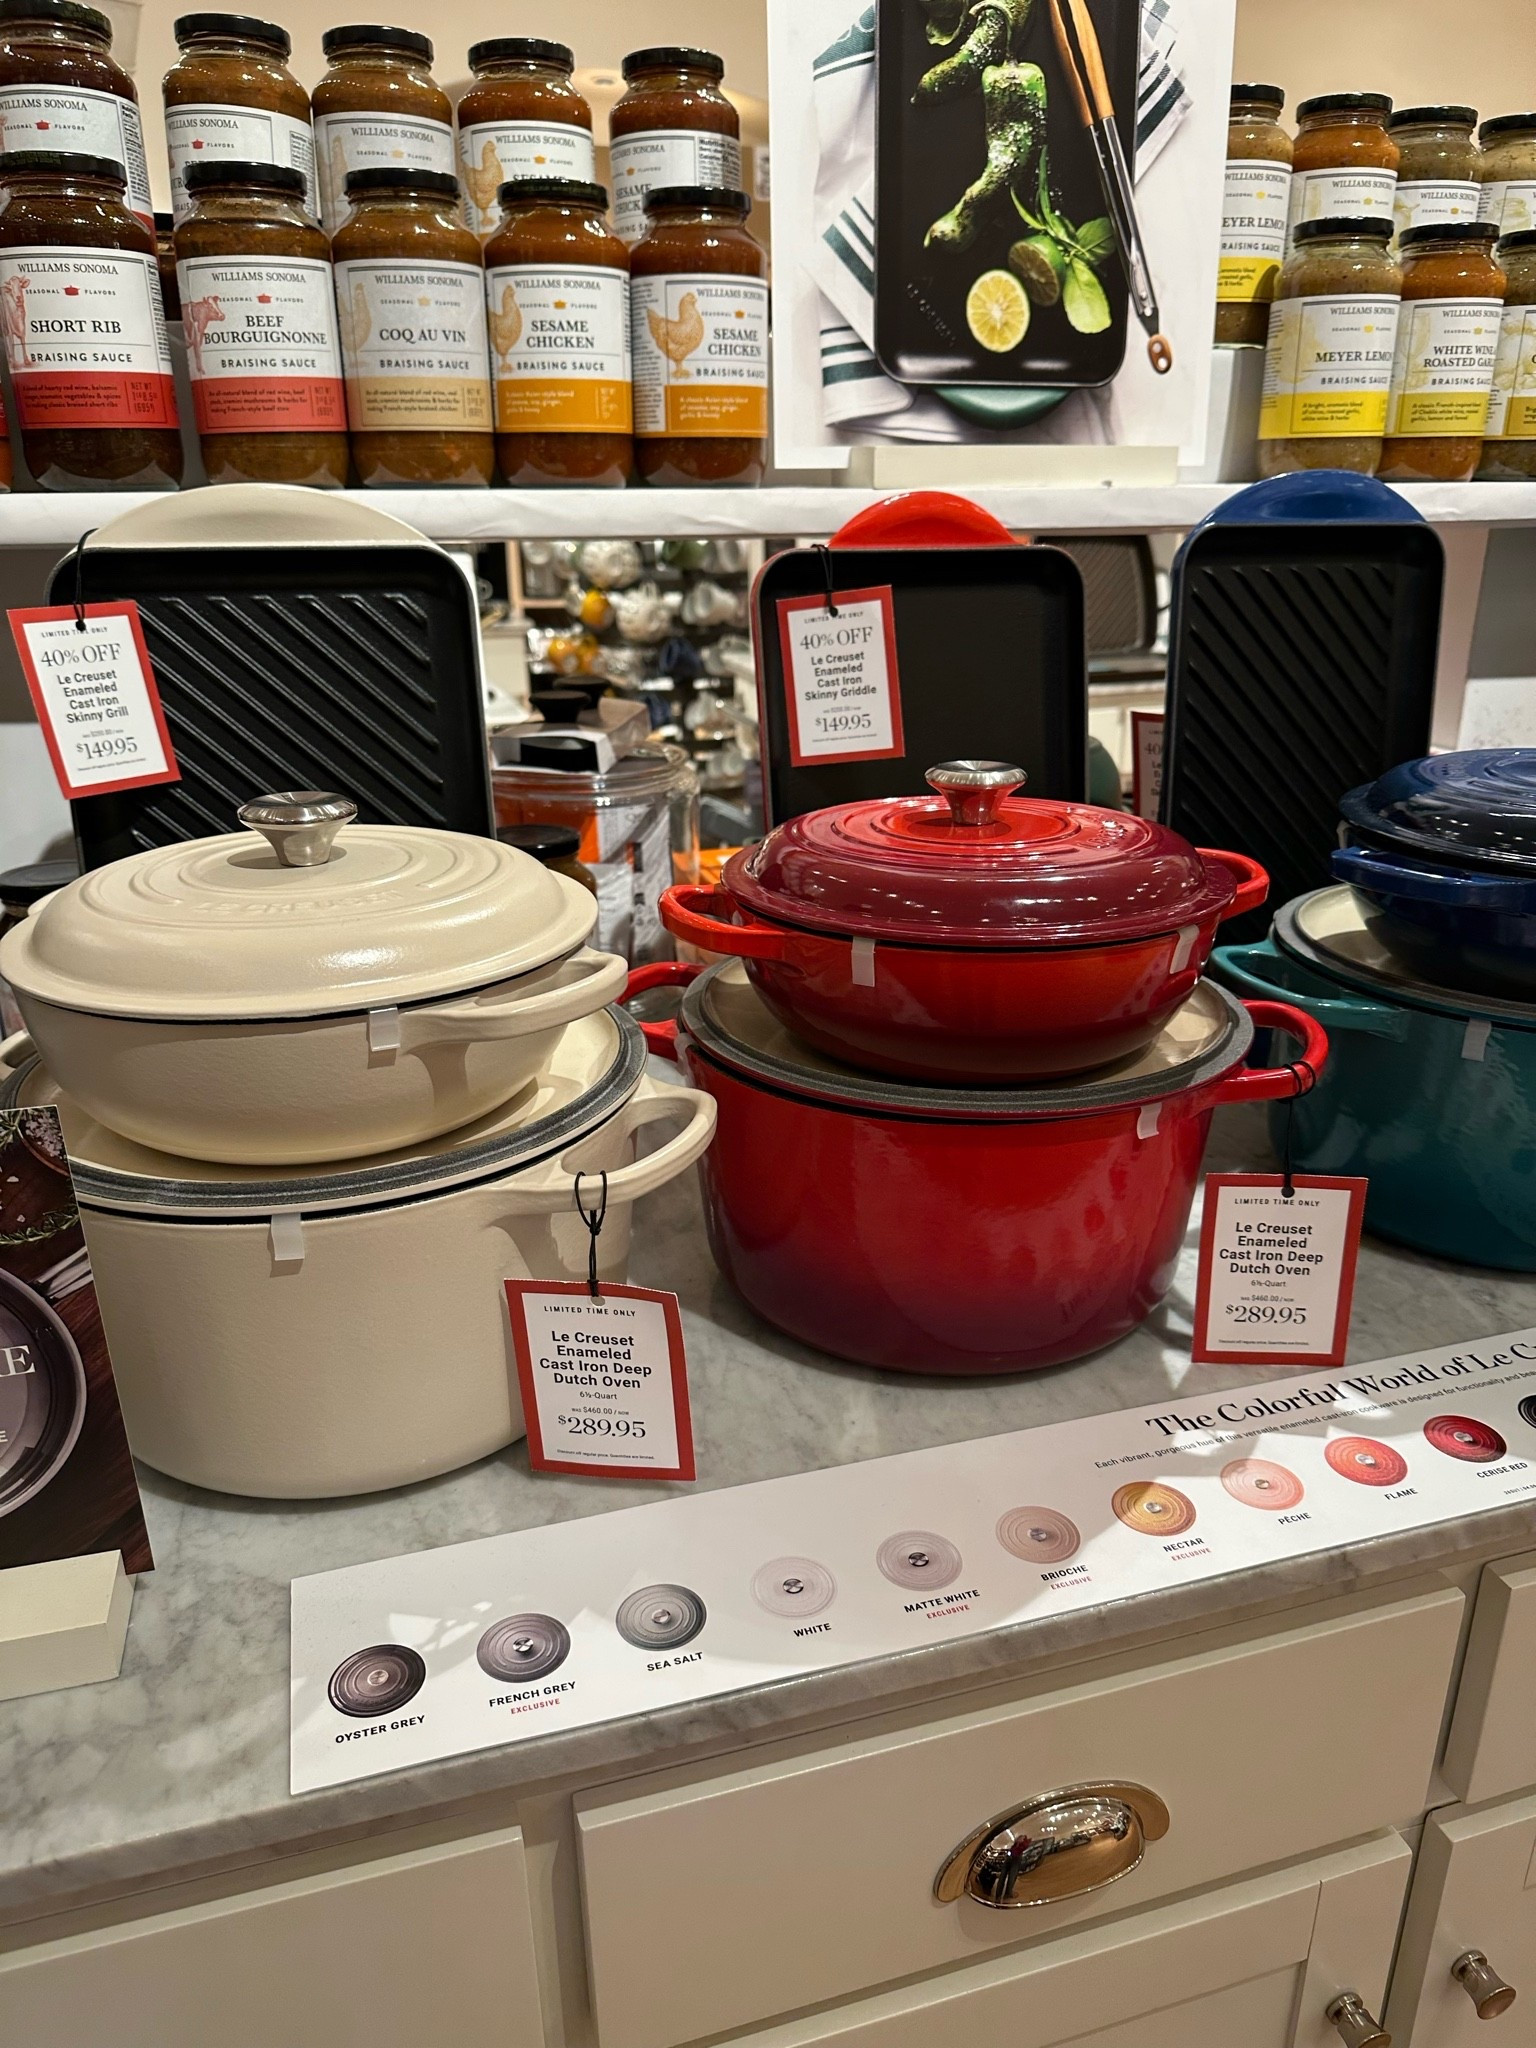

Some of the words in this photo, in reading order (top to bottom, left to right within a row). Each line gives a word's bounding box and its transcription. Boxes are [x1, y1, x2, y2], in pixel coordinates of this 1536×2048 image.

[44, 100, 88, 111] SONOMA
[199, 119, 239, 129] SONOMA
[351, 127, 399, 138] WILLIAMS
[400, 129, 435, 143] SONOMA
[495, 135, 541, 144] WILLIAMS
[542, 135, 576, 148] SONOMA
[1223, 173, 1263, 181] WILLIAMS
[1332, 180, 1371, 189] WILLIAMS
[1421, 192, 1458, 200] WILLIAMS
[1222, 217, 1255, 228] EYER
[1222, 242, 1259, 250] RAISING
[17, 263, 71, 273] WILLIAMS
[73, 264, 119, 275] SONOMA
[212, 272, 264, 282] WILLIAMS
[265, 273, 306, 283] SONOMA
[375, 275, 425, 285] WILLIAMS
[428, 276, 463, 288] SONOMA
[514, 279, 561, 289] WILLIAMS
[563, 280, 601, 291] SONOMA
[696, 288, 741, 298] WILLIAMS
[1330, 307, 1372, 315] WILLIAMS
[1442, 310, 1482, 318] WILLIAMS
[30, 320, 87, 333] SHORT
[91, 320, 122, 334] RIB
[246, 315, 284, 327] BEEF
[531, 320, 589, 333] SESAME
[204, 332, 327, 345] BOURGUIGNONNE
[380, 328, 416, 344] COQ
[418, 330, 437, 341] AU
[442, 330, 466, 343] VIN
[713, 328, 759, 342] SESAME
[526, 336, 595, 349] CHICKEN
[708, 343, 762, 357] CHICKEN
[1315, 351, 1362, 362] MEYER
[1434, 346, 1472, 355] WHITE
[30, 352, 88, 362] BRAISING
[93, 353, 133, 363] SAUCE
[221, 358, 277, 368] BRAISING
[282, 359, 316, 368] SAUCE
[1424, 358, 1475, 368] ROASTED
[380, 360, 434, 369] BRAISING
[439, 361, 470, 370] SAUCE
[517, 361, 568, 371] BRAISING
[572, 362, 605, 371] SAUCE
[696, 368, 744, 377] BRAISING
[1321, 376, 1366, 385] BRAISING
[41, 630, 70, 638] LIMITED
[91, 626, 108, 634] ONLY
[800, 633, 834, 650] 40%
[837, 627, 873, 645] OFF
[41, 649, 80, 667] 40%
[82, 643, 122, 664] OFF
[811, 656, 823, 666] Le
[826, 652, 865, 664] Creuset
[815, 663, 863, 677] Enameled
[57, 674, 71, 685] Le
[75, 670, 117, 683] Creuset
[817, 678, 840, 688] Cast
[842, 676, 862, 685] Iron
[64, 682, 117, 697] Enameled
[805, 691, 838, 702] Skinny
[841, 685, 877, 697] Griddle
[70, 699, 95, 710] Cast
[98, 695, 119, 706] Iron
[66, 713, 103, 724] Skinny
[106, 706, 129, 718] Grill
[815, 714, 872, 732] $149.95
[76, 737, 138, 760] $149.95
[1236, 1222, 1252, 1232] Le
[1257, 1223, 1312, 1235] Creuset
[1238, 1236, 1307, 1248] Enameled
[1219, 1249, 1251, 1260] Cast
[1256, 1250, 1282, 1261] Iron
[1288, 1252, 1324, 1265] Deep
[1230, 1263, 1270, 1274] Dutch
[1275, 1265, 1310, 1276] Oven
[544, 1305, 582, 1313] LIMITED
[613, 1309, 636, 1317] ONLY
[1225, 1304, 1307, 1325] $289.95
[551, 1330, 570, 1342] Le
[574, 1332, 634, 1346] Creuset
[557, 1345, 632, 1360] Enameled
[540, 1358, 575, 1371] Cast
[579, 1360, 608, 1373] Iron
[613, 1362, 652, 1377] Deep
[554, 1373, 597, 1386] Dutch
[602, 1376, 641, 1389] Oven
[1144, 1413, 1216, 1437] The
[1217, 1384, 1348, 1422] Colorful
[1341, 1364, 1442, 1396] World
[1441, 1357, 1474, 1377] of
[1465, 1353, 1513, 1370] Le
[1510, 1343, 1536, 1360] C
[583, 1406, 613, 1415] $460.00
[558, 1414, 646, 1439] $289.95
[1095, 1459, 1119, 1469] Each
[1120, 1450, 1155, 1464] vibrant,
[1155, 1442, 1198, 1458] gorgeous
[1198, 1438, 1214, 1447] hue
[1226, 1432, 1242, 1441] this
[1243, 1425, 1278, 1438] versatile
[1280, 1416, 1321, 1431] enameled
[1321, 1409, 1359, 1422] cast-iron
[1359, 1400, 1398, 1413] cookware
[1408, 1390, 1442, 1404] designed
[1443, 1387, 1456, 1395] for
[1456, 1377, 1505, 1394] functionality
[1505, 1374, 1520, 1382] and
[1477, 1467, 1510, 1479] CERISE
[1509, 1462, 1528, 1473] RED
[1384, 1488, 1418, 1501] FLAME
[1277, 1512, 1312, 1526] PÊCHE
[1163, 1537, 1205, 1553] NECTAR
[1171, 1547, 1211, 1561] EXCLUSIVE
[1040, 1565, 1089, 1582] BRIOCHE
[1050, 1576, 1092, 1590] EXCLUSIVE
[904, 1597, 943, 1613] MATTE
[944, 1589, 981, 1604] WHITE
[926, 1604, 970, 1619] EXCLUSIVE
[793, 1622, 832, 1637] WHITE
[647, 1660, 671, 1672] SEA
[674, 1651, 704, 1666] SALT
[489, 1689, 540, 1708] FRENCH
[543, 1681, 576, 1696] GREY
[510, 1698, 561, 1715] EXCLUSIVE
[335, 1724, 387, 1744] OYSTER
[390, 1714, 426, 1731] GREY
